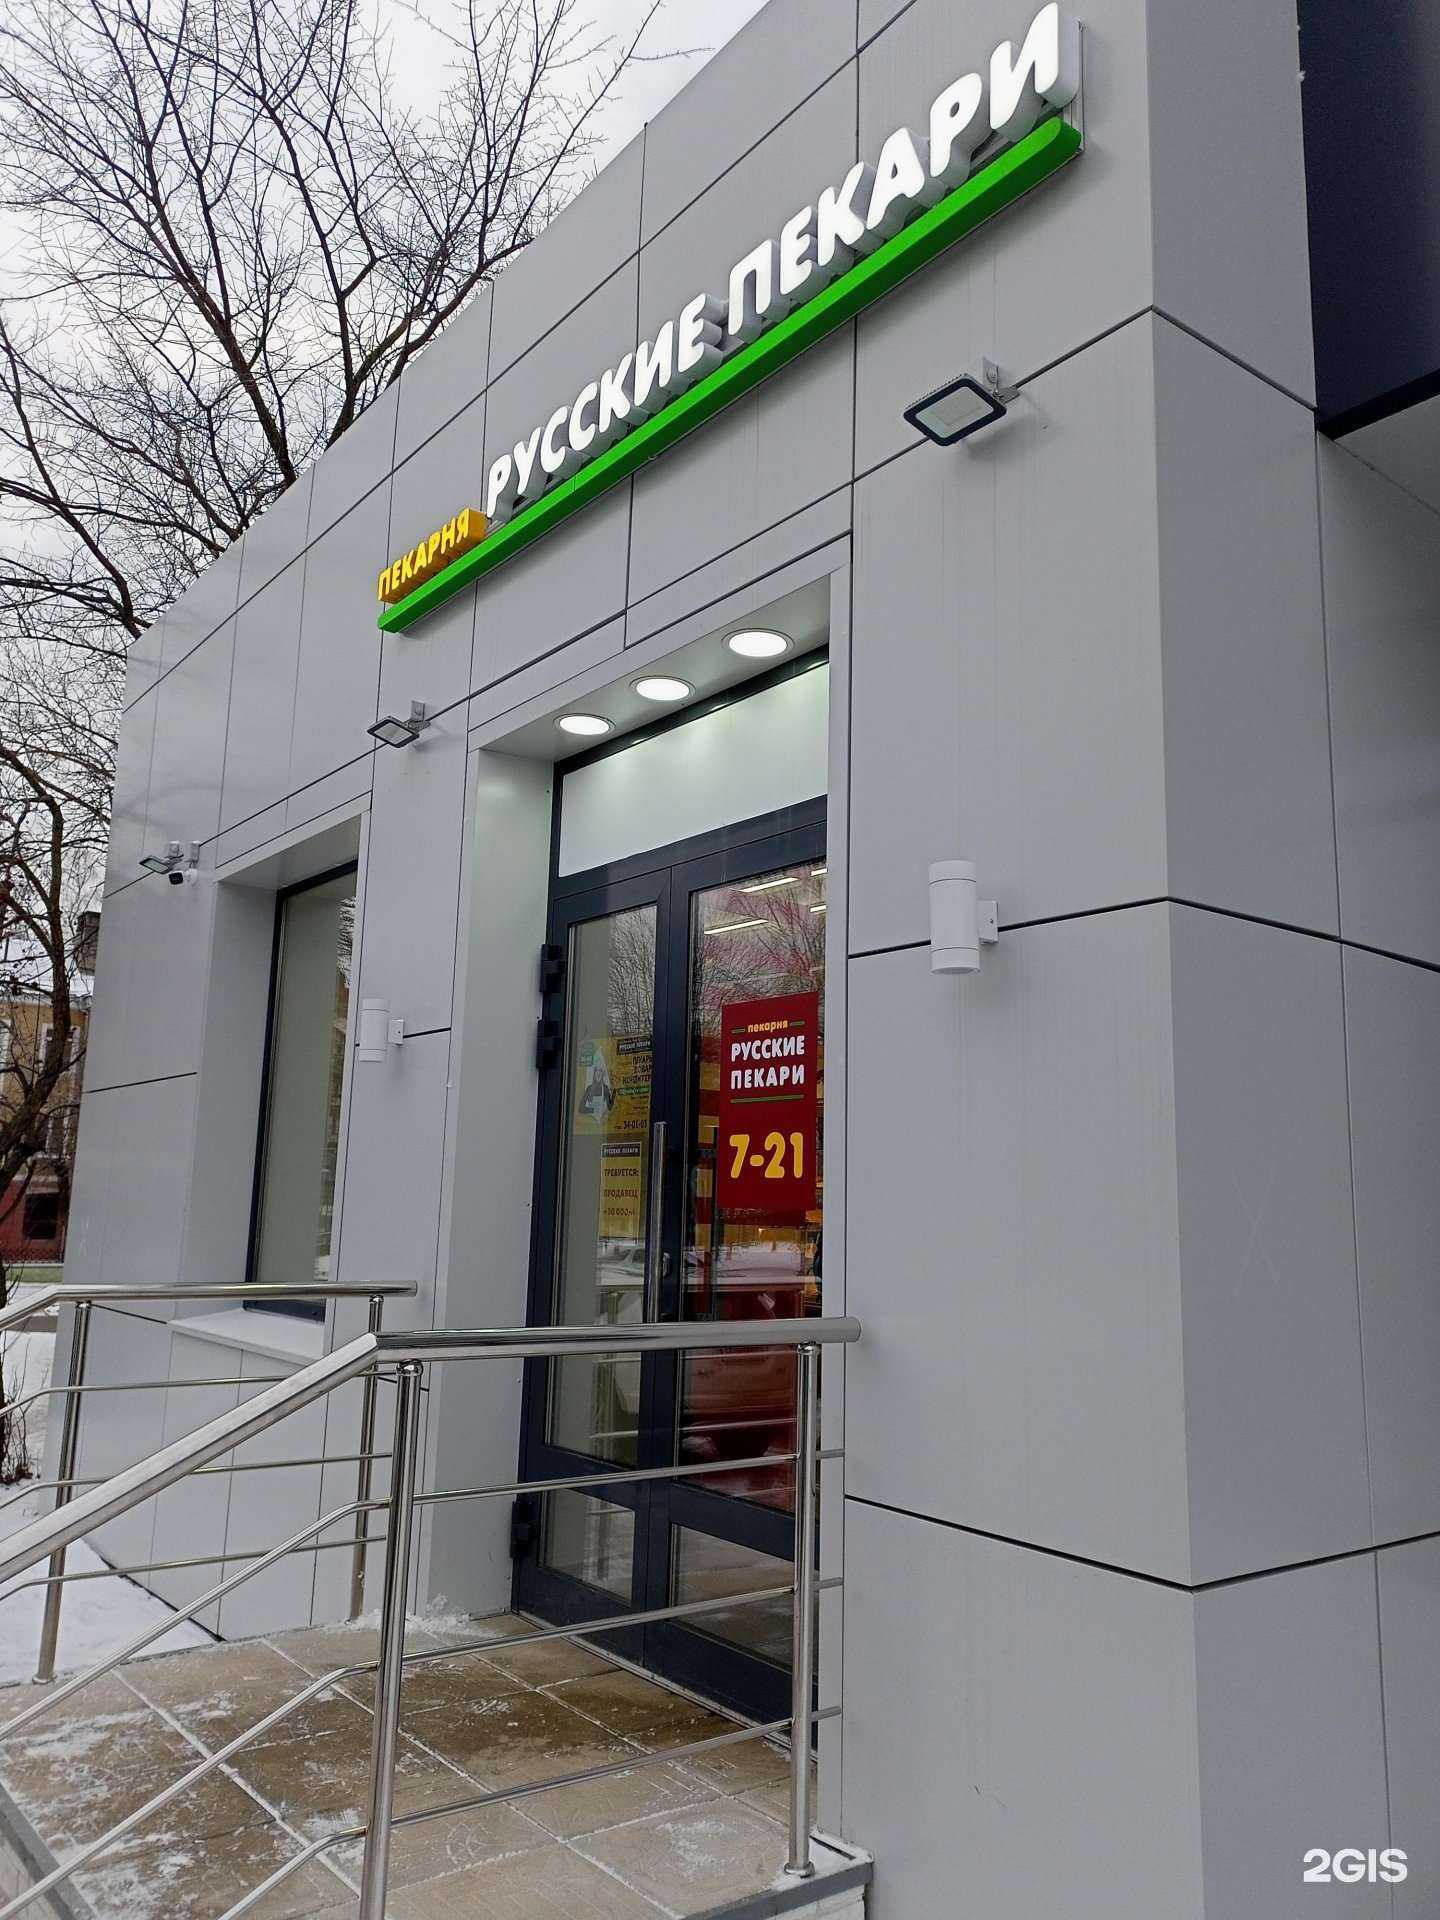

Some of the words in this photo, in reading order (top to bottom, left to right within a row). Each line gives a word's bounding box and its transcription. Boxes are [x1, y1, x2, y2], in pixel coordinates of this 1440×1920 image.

[486, 293, 711, 518] РУССКИЕ
[728, 2, 1060, 335] ПЕКАРИ
[378, 508, 470, 601] ПЕКАРНЯ
[748, 1020, 788, 1033] пекарня
[731, 1035, 805, 1062] РУССКИЕ
[731, 1064, 805, 1090] ПЕКАРИ
[729, 1132, 804, 1179] 7-21
